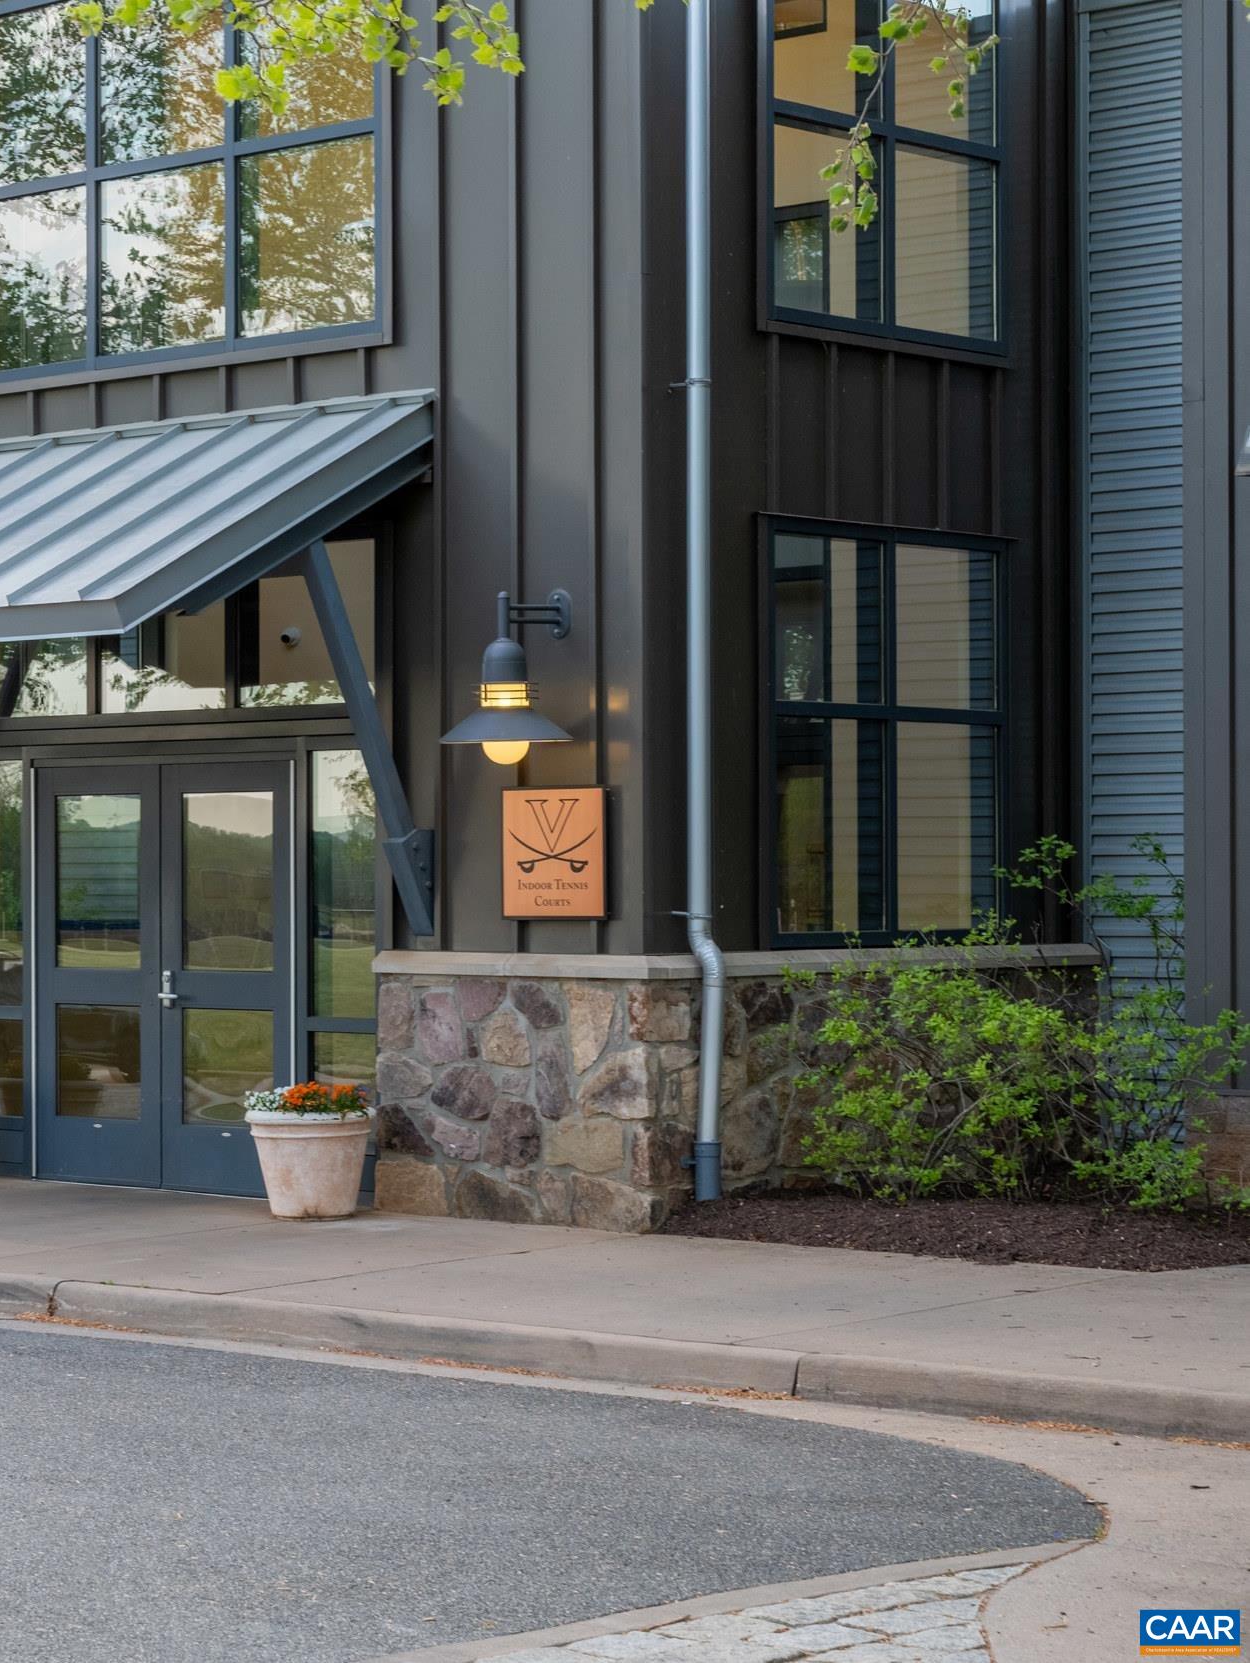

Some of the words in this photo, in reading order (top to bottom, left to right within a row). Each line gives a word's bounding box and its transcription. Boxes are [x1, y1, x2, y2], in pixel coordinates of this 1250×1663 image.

[517, 879, 553, 890] INDOOR
[553, 878, 589, 890] TENNIS
[534, 895, 571, 907] COURTS
